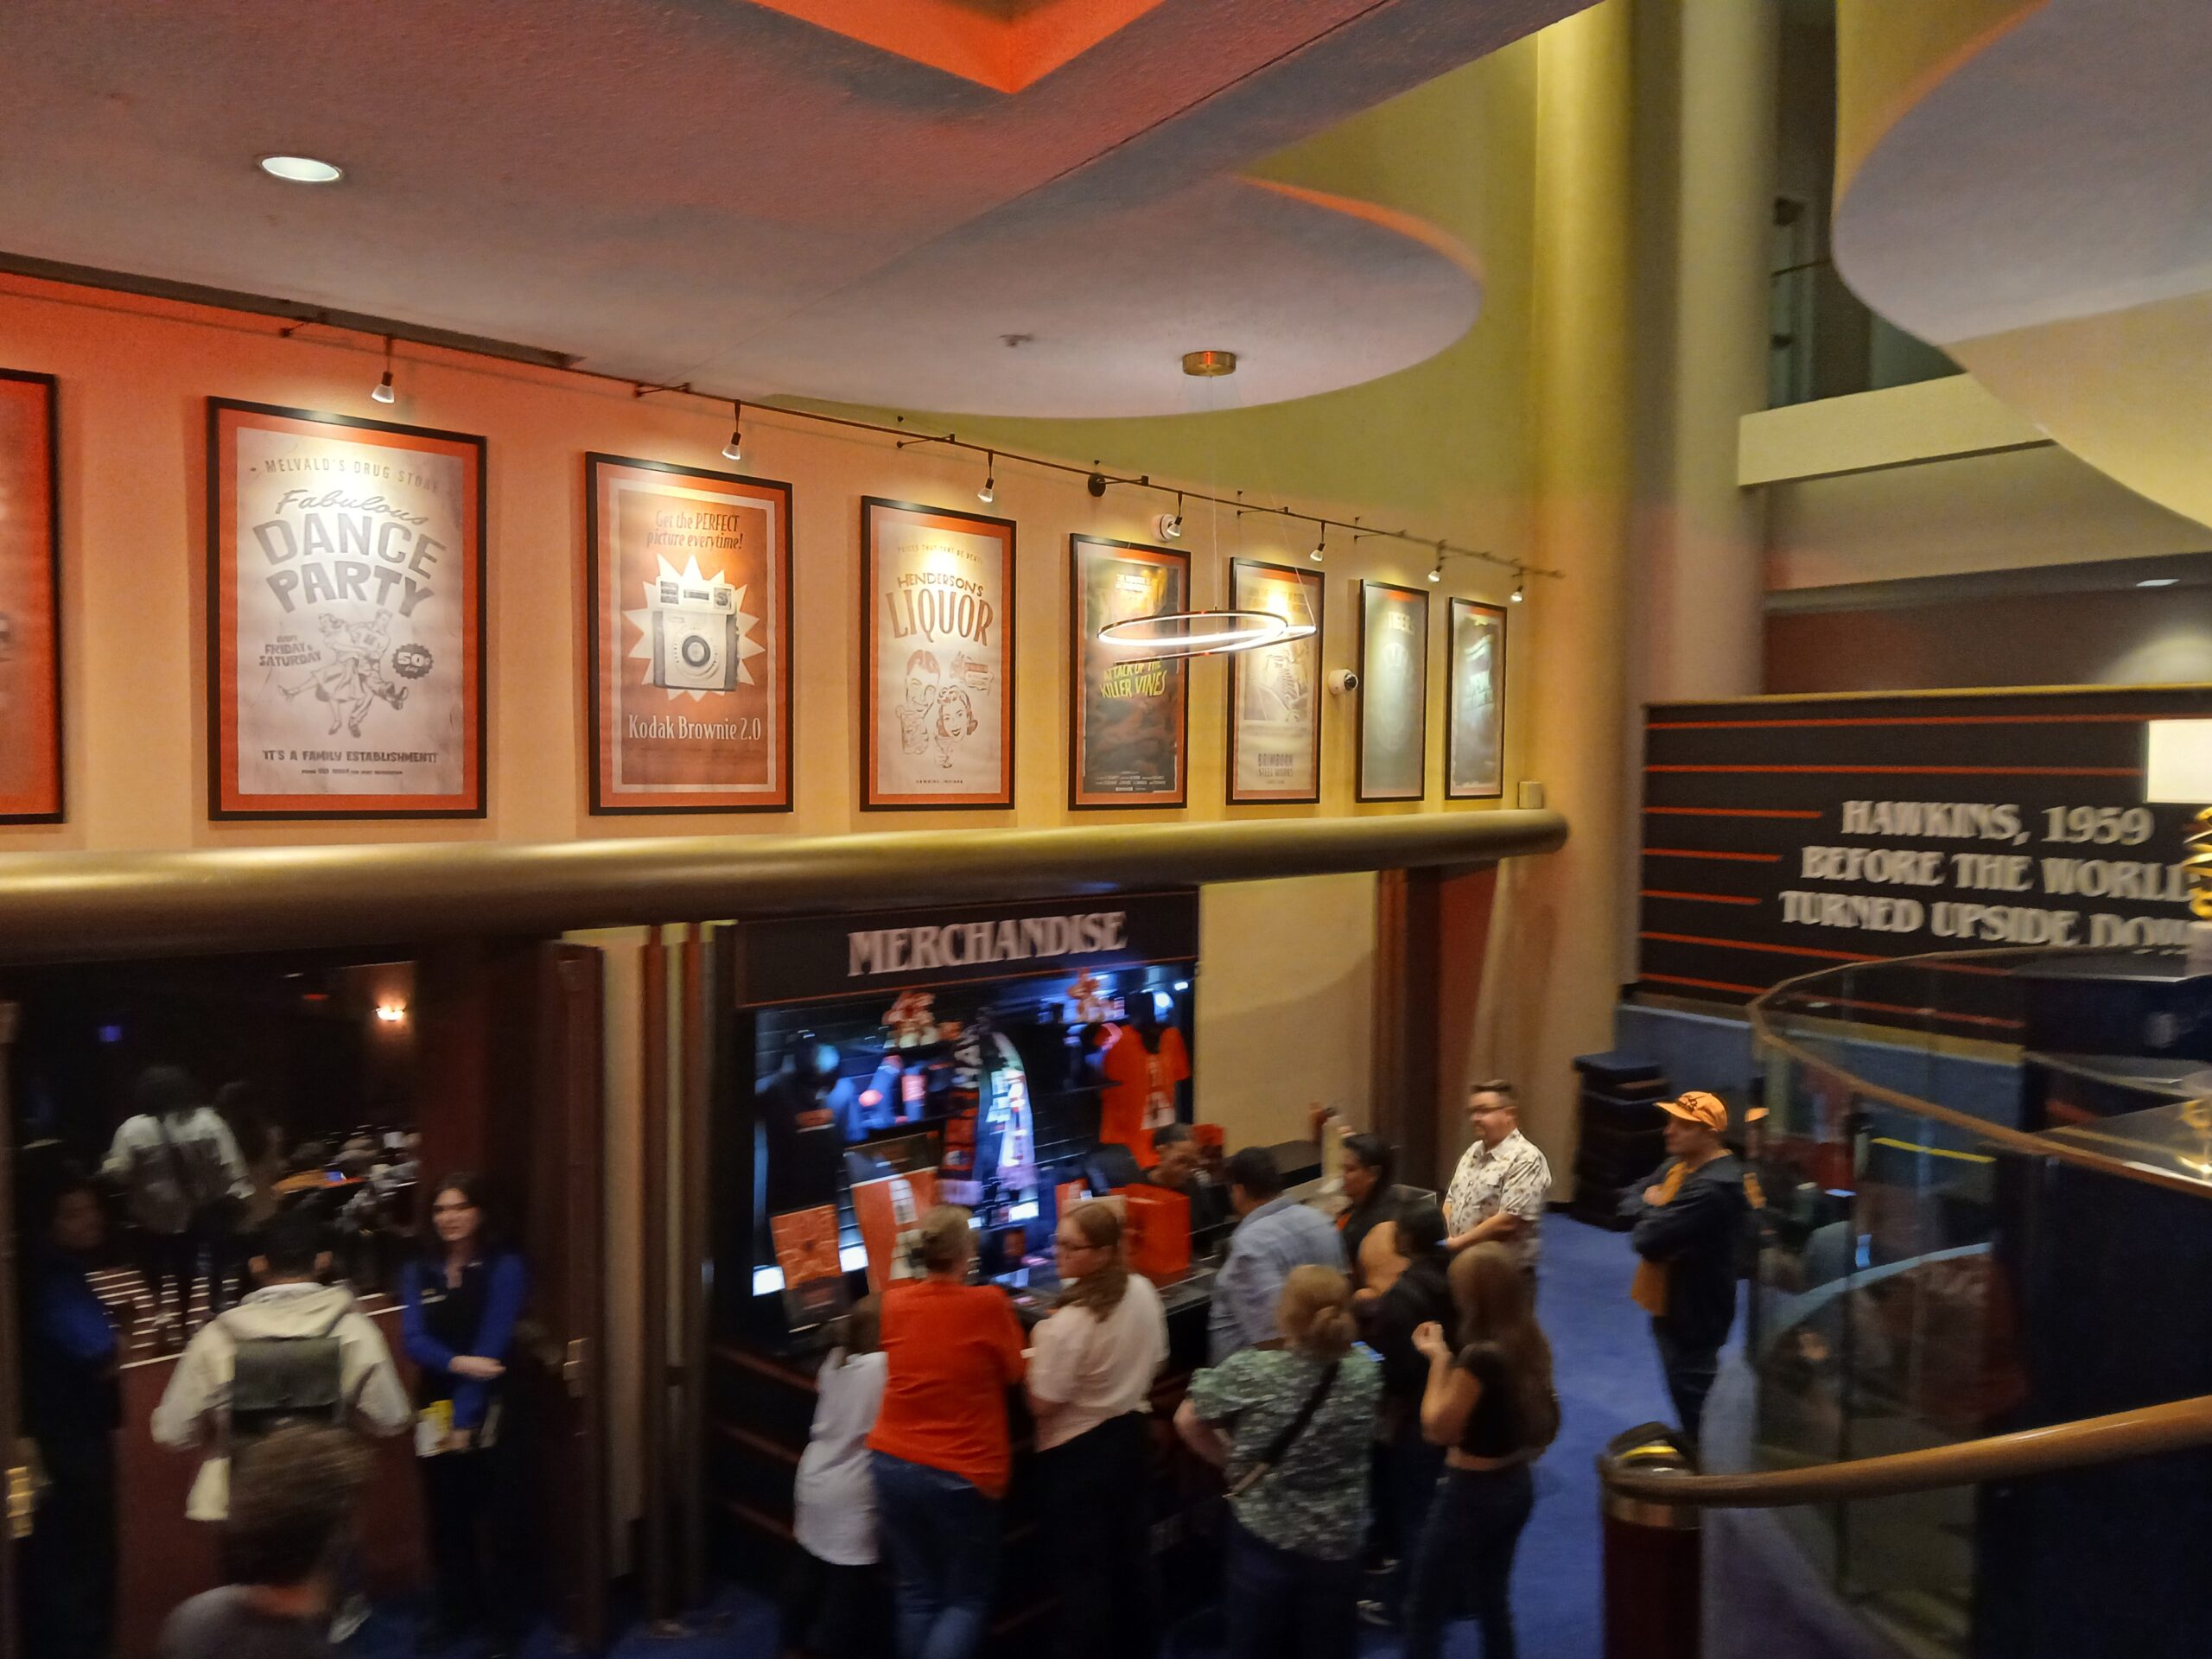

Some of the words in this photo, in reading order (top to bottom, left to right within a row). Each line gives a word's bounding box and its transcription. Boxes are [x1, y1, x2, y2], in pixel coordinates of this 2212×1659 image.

[265, 458, 345, 474] MELVALD'S
[354, 461, 391, 480] DRUG
[275, 489, 429, 525] Fabulous
[656, 510, 673, 528] Get
[677, 512, 693, 529] the
[695, 512, 740, 532] PERFECT
[252, 512, 447, 580] DANCE
[646, 528, 685, 549] picture
[687, 531, 744, 552] everytime!
[266, 561, 435, 618] PARTY
[897, 572, 984, 597] HENDERSON'S
[885, 588, 994, 646] LIQUOR
[259, 651, 321, 667] SATURDAY
[264, 641, 307, 655] FRIDAY
[1099, 679, 1133, 698] KILLER
[1135, 670, 1168, 696] VINES
[1103, 663, 1134, 681] ATTACK
[628, 714, 675, 740] Kodak
[677, 715, 737, 741] Brownie
[741, 717, 761, 741] 2.0
[289, 750, 298, 761] A
[302, 751, 342, 762] FAMILY
[1840, 800, 2031, 846] HAWKINS,
[2040, 805, 2155, 846] 1959
[1801, 845, 1947, 887] BEFORE
[1950, 852, 2037, 892] THE
[1778, 890, 1924, 933] TURNED
[1930, 901, 2082, 948] UPSIDE
[2089, 912, 2195, 948] DOW
[847, 911, 1128, 977] MERCHANDISE
